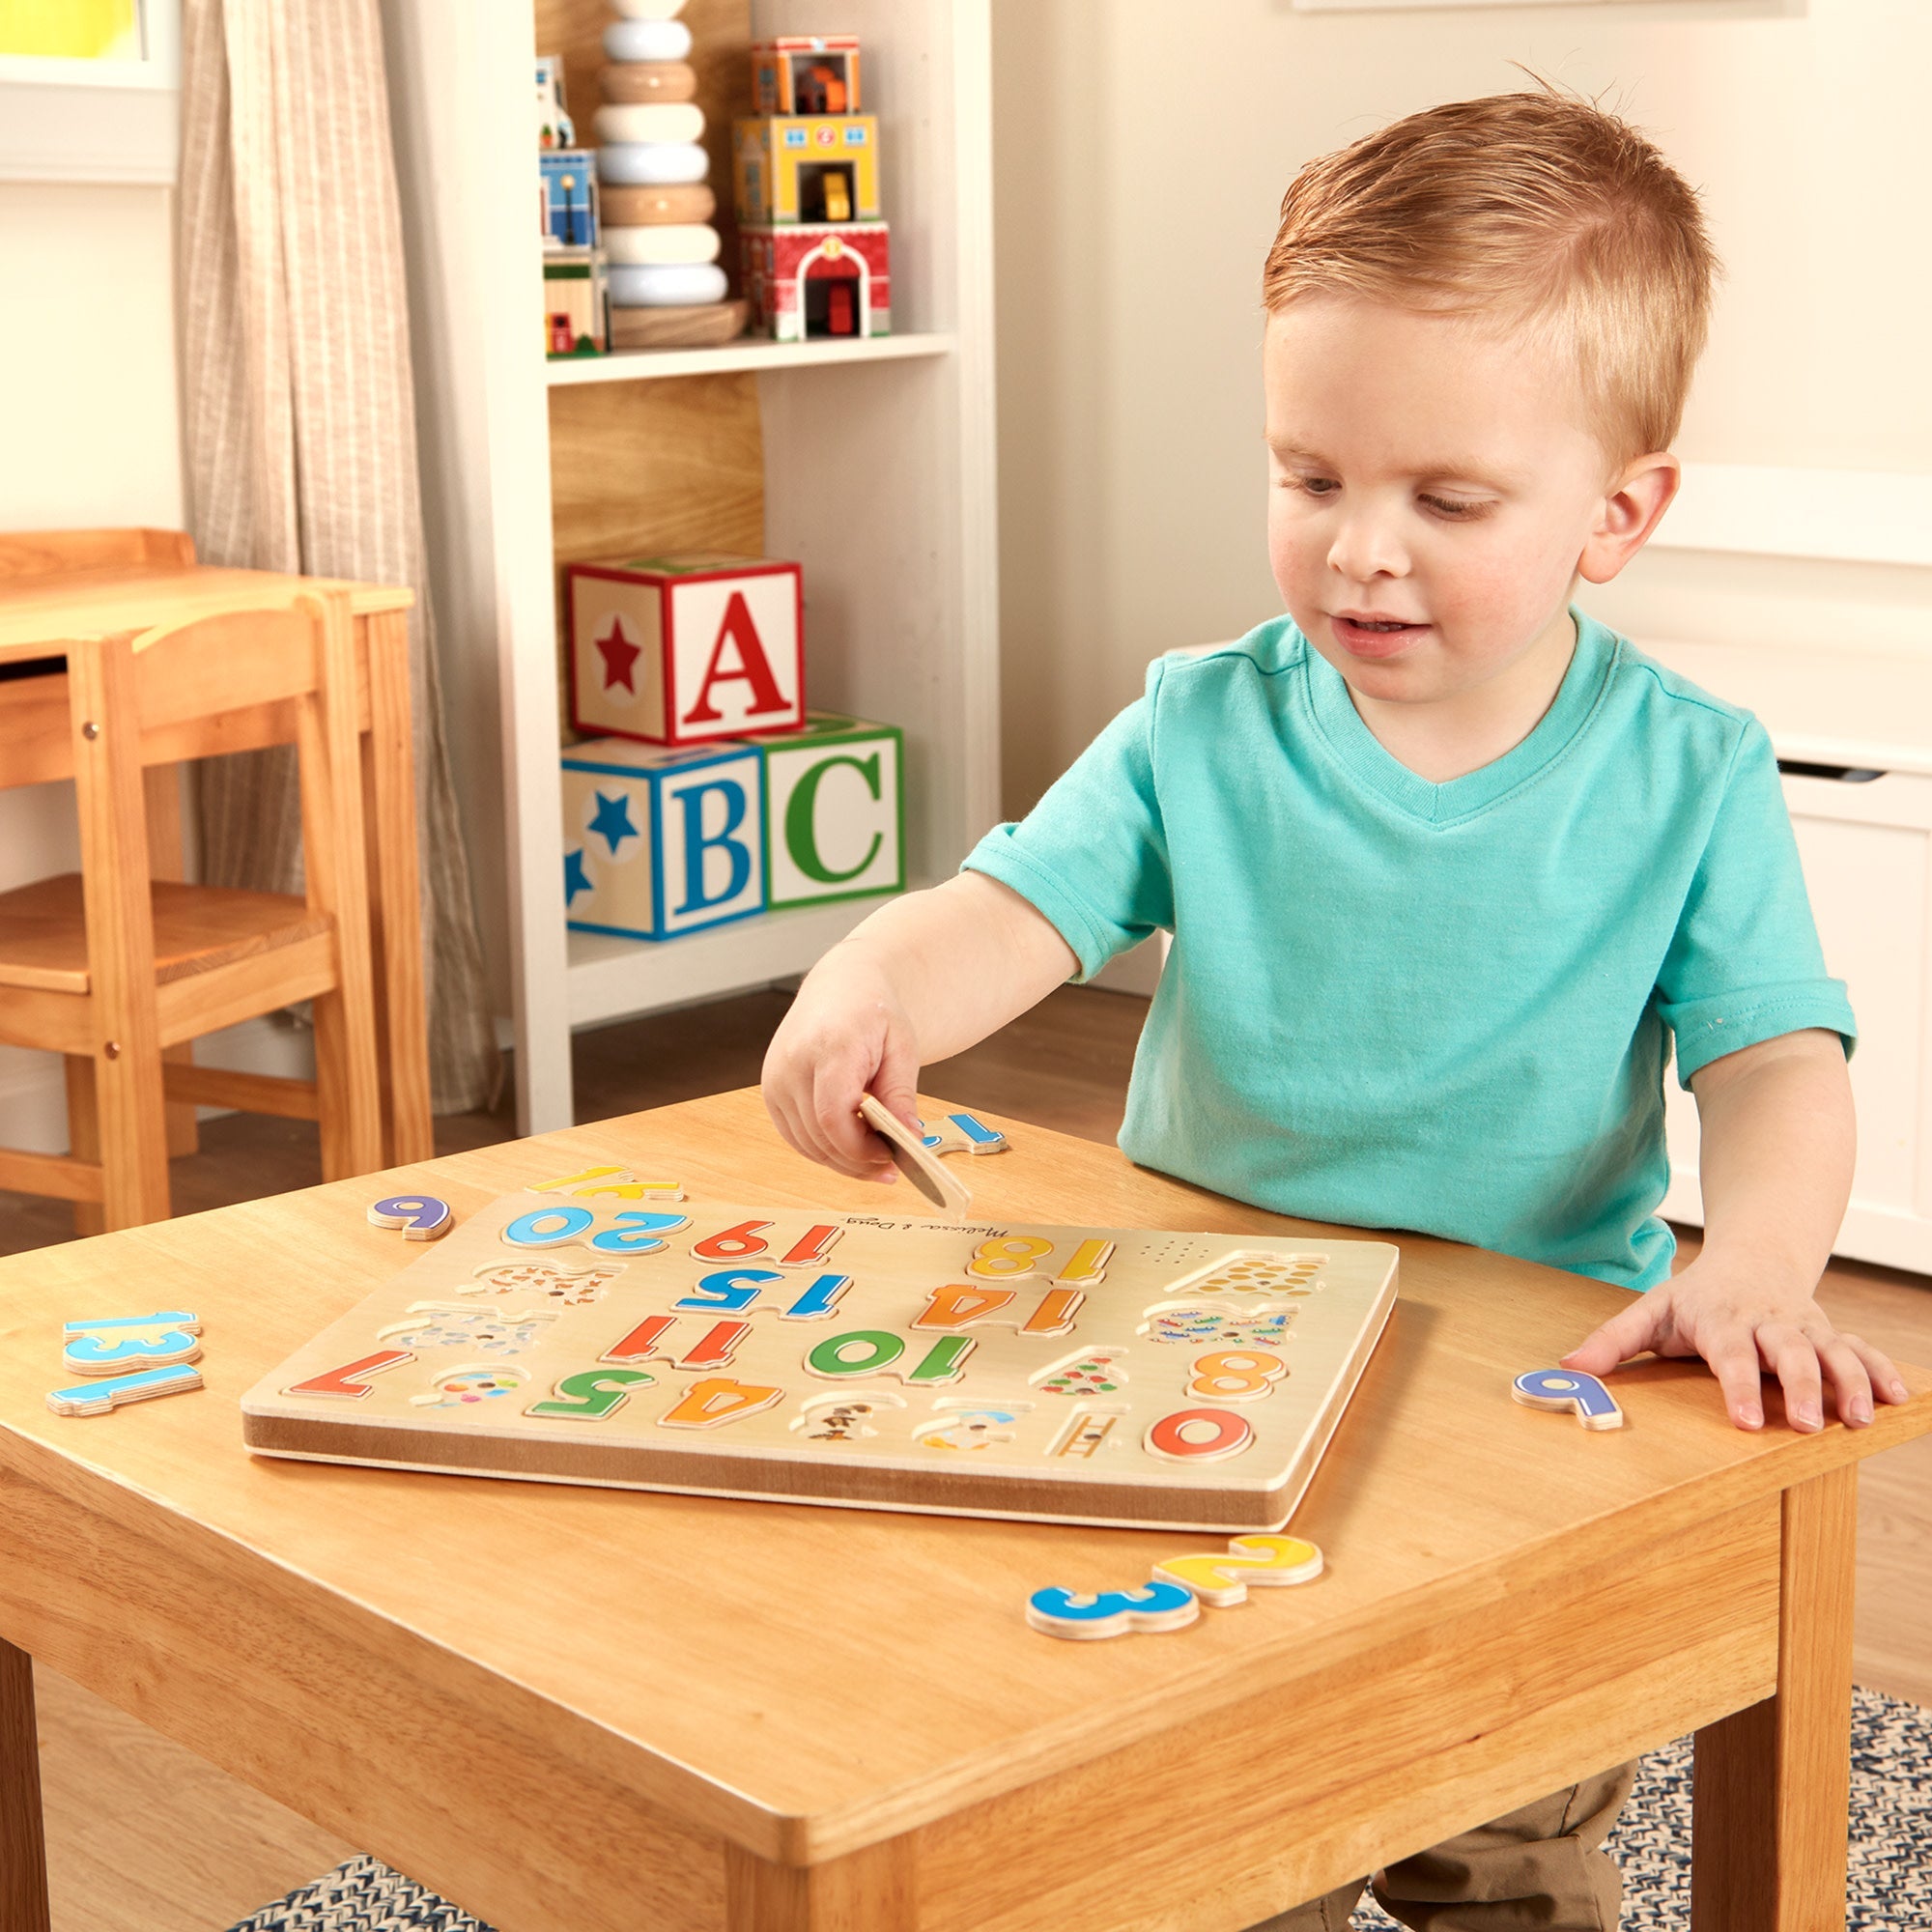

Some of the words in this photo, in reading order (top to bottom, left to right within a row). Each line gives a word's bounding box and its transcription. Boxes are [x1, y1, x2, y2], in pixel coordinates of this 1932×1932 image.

[682, 591, 793, 724] A
[671, 779, 751, 916] B
[784, 752, 883, 884] C
[505, 1206, 688, 1253] 20
[693, 1221, 838, 1264] 19
[841, 1216, 895, 1230] Doug
[922, 1224, 1009, 1237] Melissa
[970, 1236, 1108, 1281] 18
[674, 1268, 849, 1317] 15
[919, 1287, 1079, 1331] 14
[612, 1316, 751, 1364] 11
[810, 1330, 972, 1379] 10
[532, 1370, 654, 1415] 5
[1191, 1351, 1284, 1396] 8
[663, 1378, 783, 1423] 4
[1161, 1536, 1316, 1590] 2
[1031, 1581, 1193, 1621] 3
